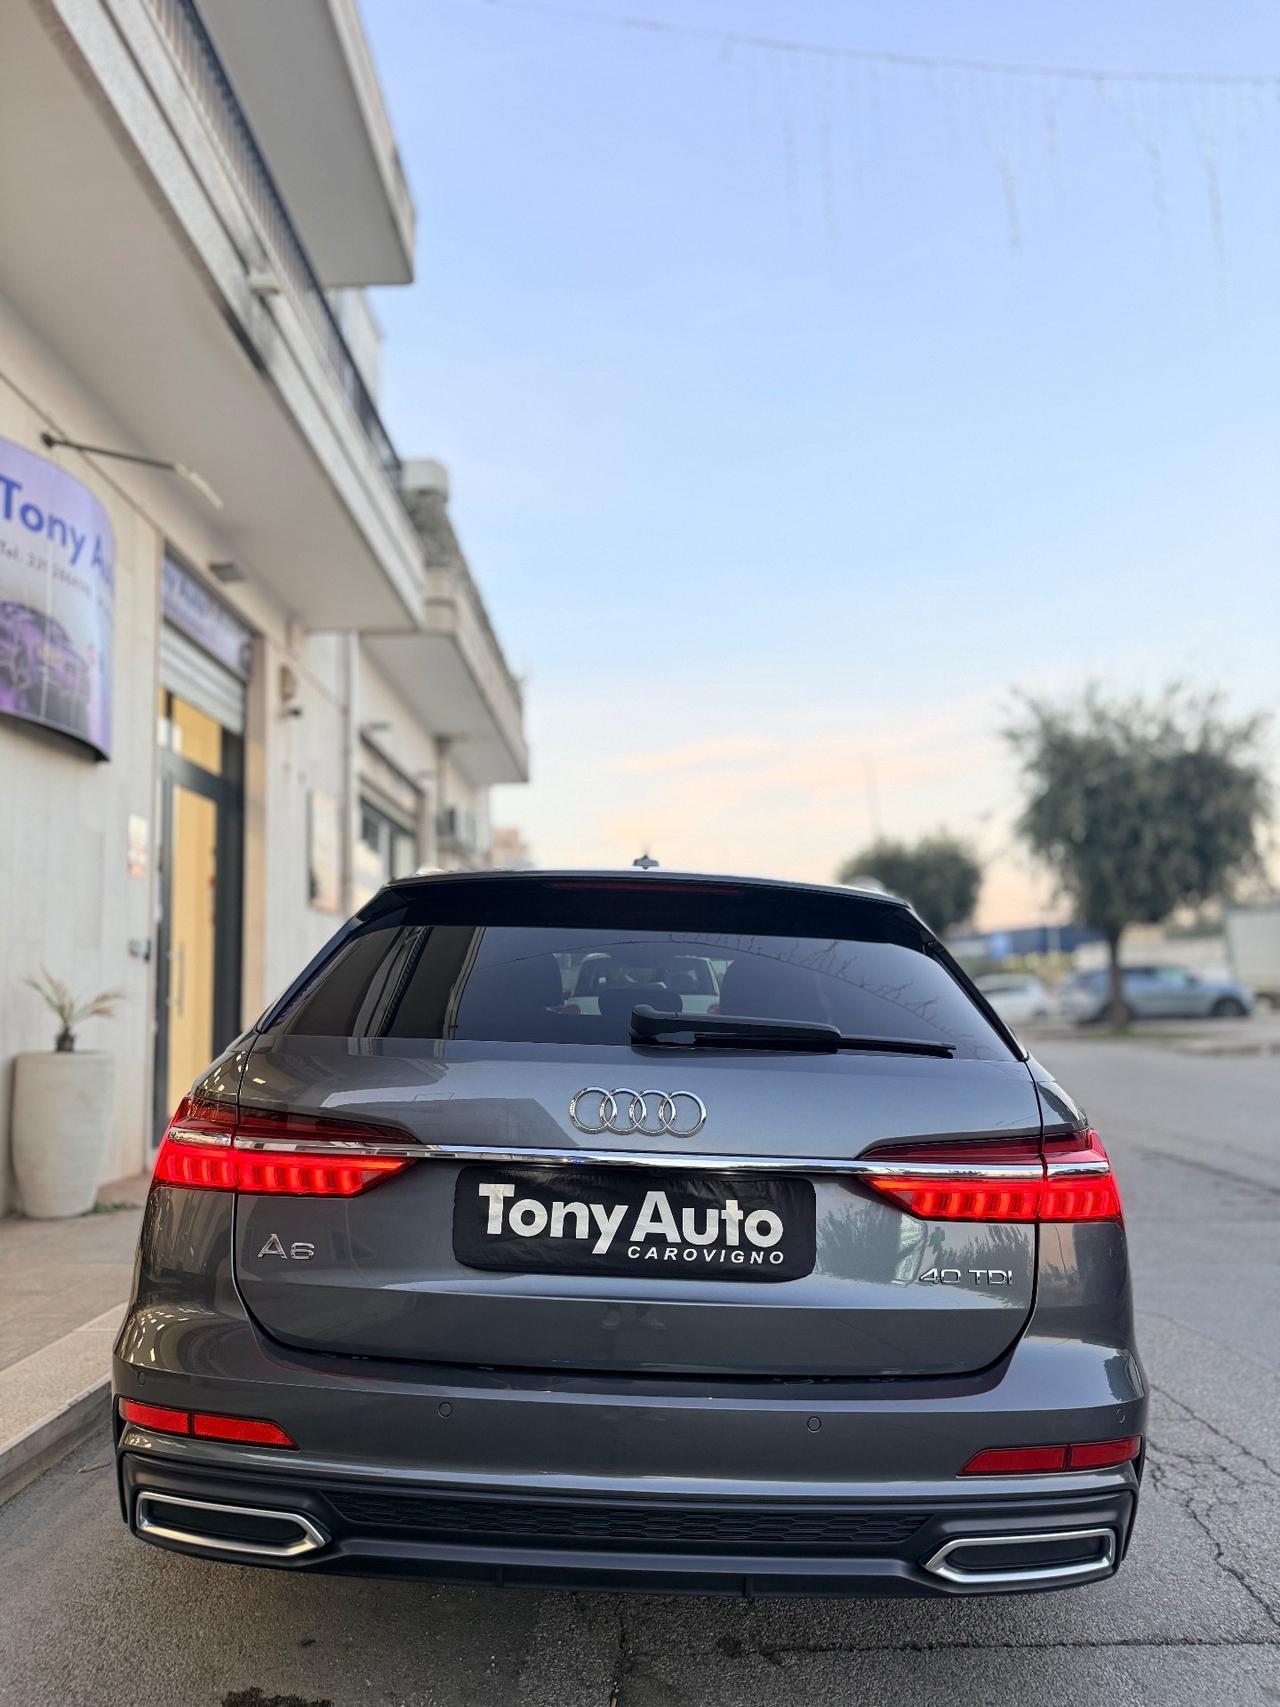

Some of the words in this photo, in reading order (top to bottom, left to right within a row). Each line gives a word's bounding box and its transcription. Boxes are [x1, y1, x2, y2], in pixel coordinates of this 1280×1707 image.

[0, 473, 86, 567] Tony
[478, 1183, 629, 1254] Tony
[629, 1191, 784, 1248] Auto
[257, 1233, 315, 1260] A6
[627, 1246, 784, 1264] CAROVIGNO
[920, 1268, 961, 1285] 40
[968, 1269, 1013, 1286] TDI
